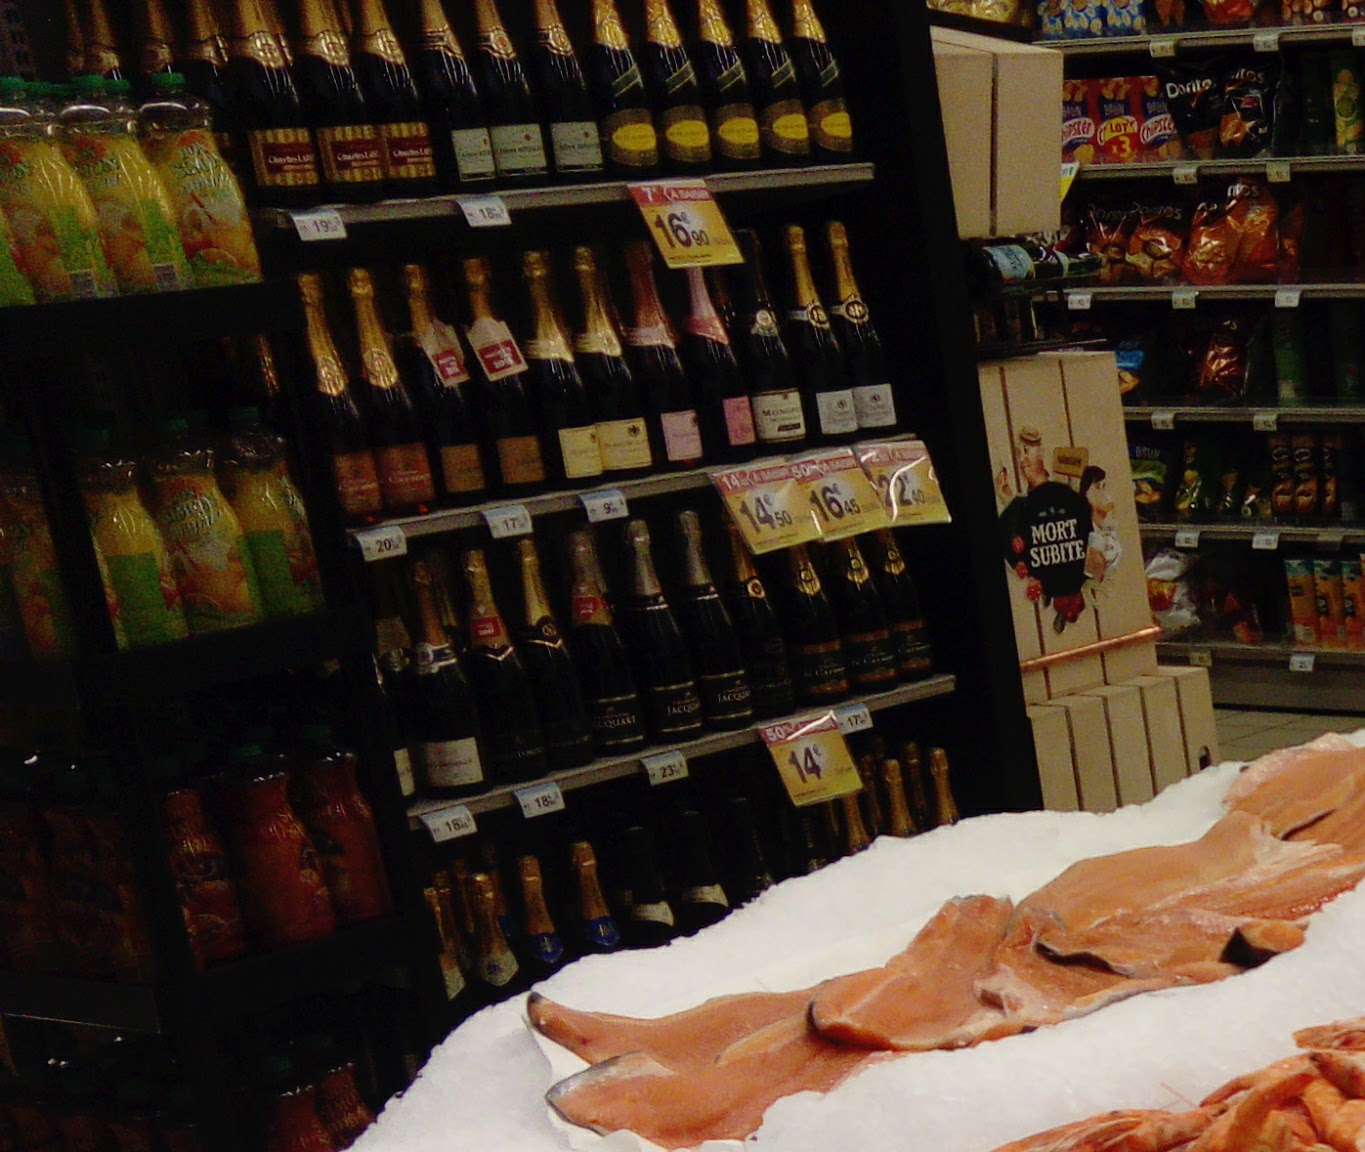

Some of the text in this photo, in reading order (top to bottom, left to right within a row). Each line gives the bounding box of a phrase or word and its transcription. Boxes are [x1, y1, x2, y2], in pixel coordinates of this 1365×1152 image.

[656, 213, 692, 248] 16
[691, 230, 710, 247] 90
[740, 497, 775, 533] 14
[775, 510, 793, 527] 50
[810, 483, 845, 522] 16
[376, 539, 392, 552] 20
[1030, 518, 1078, 546] MORT
[1029, 539, 1086, 568] SUBITE
[661, 766, 675, 778] 23
[788, 747, 822, 784] 14
